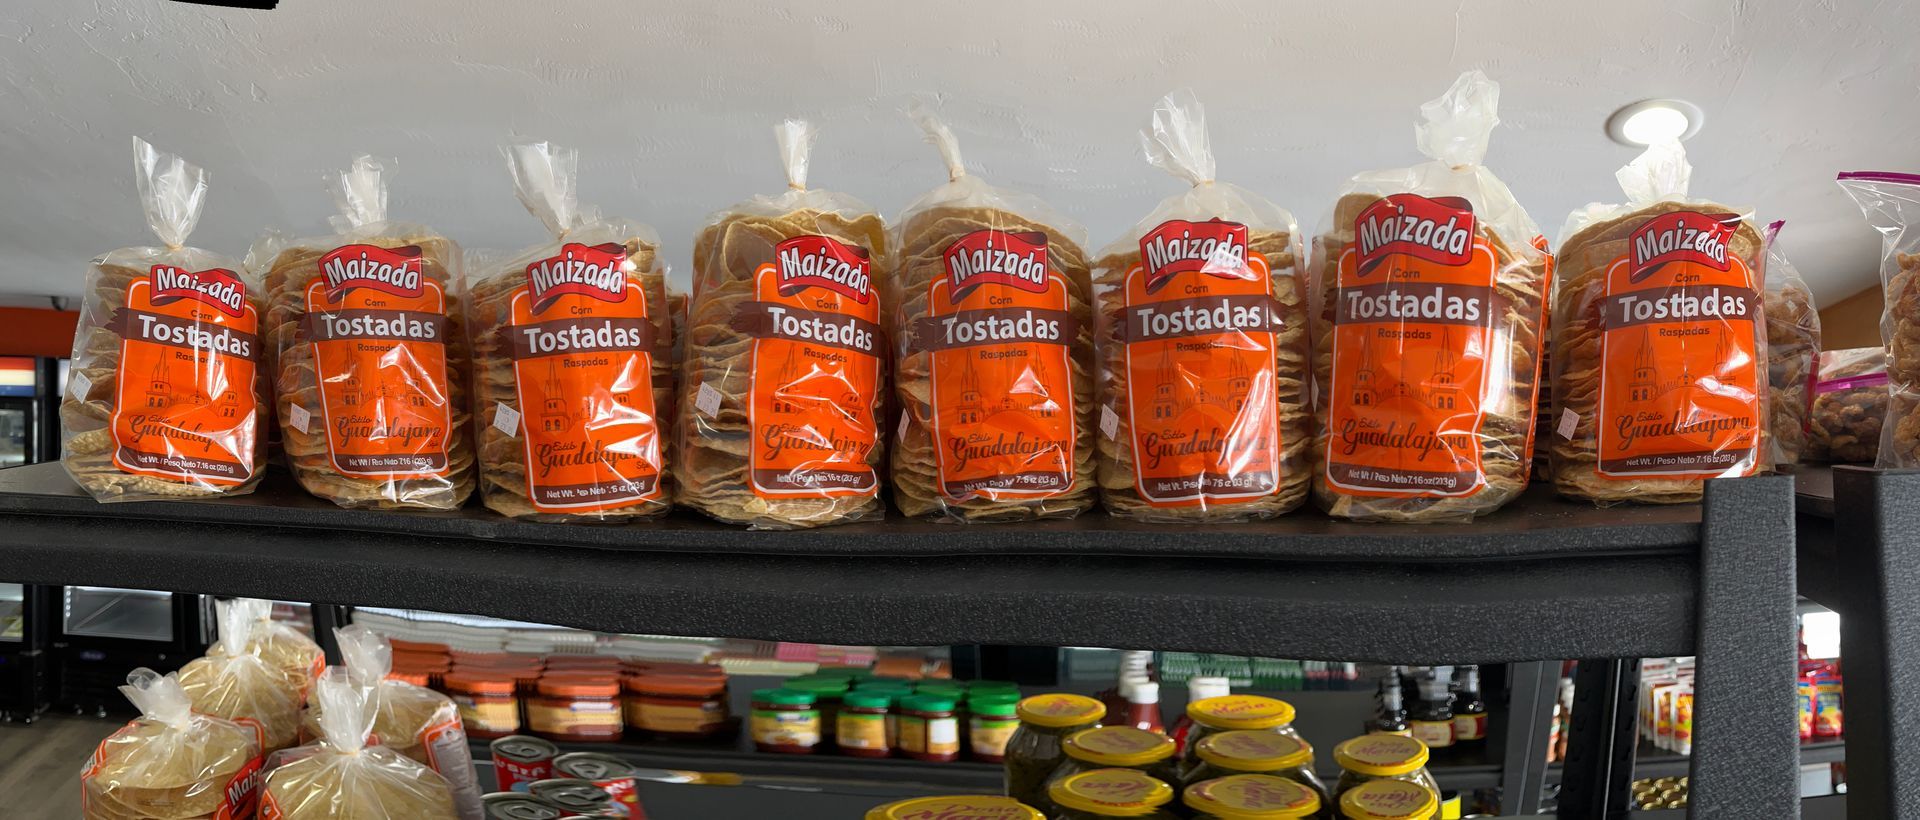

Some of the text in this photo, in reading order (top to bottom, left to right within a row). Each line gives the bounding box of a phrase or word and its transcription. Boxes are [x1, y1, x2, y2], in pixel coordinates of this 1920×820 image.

[1360, 206, 1468, 257] Maizada
[1635, 220, 1725, 266] Maizada
[950, 240, 1045, 286] Maizada
[1146, 230, 1243, 274] Maizada
[324, 252, 419, 290] Maizada
[531, 251, 623, 296] Maizada
[780, 246, 870, 296] Maizada
[1393, 268, 1420, 279] Corn
[1675, 273, 1700, 283] Corn
[156, 267, 242, 311] Maizada
[989, 296, 1013, 305] Corn
[1184, 284, 1209, 294] Corn
[190, 309, 213, 321] Corn
[364, 298, 386, 307] Corn
[571, 305, 593, 315] Corn
[816, 300, 839, 310] Corn
[1347, 287, 1480, 321] Tostadas
[1618, 287, 1746, 323] Tostadas
[321, 313, 436, 339] Tostadas
[767, 306, 873, 351] Tostadas
[942, 310, 1060, 345] Tostadas
[1137, 298, 1261, 336] Tostadas
[138, 315, 250, 357] Tostadas
[523, 320, 641, 354] Tostadas
[1377, 328, 1432, 341] Raspadas
[1659, 328, 1710, 339] Raspadas
[563, 357, 609, 369] Raspadas
[803, 348, 848, 363] Raspadas
[980, 348, 1029, 360] Raspadas
[1626, 458, 1639, 466] Net
[1640, 457, 1652, 466] Wt.
[1657, 456, 1675, 465] Peso
[1677, 456, 1695, 464] Neto
[1696, 455, 1712, 464] 7.16
[1407, 475, 1424, 485] 7.16
